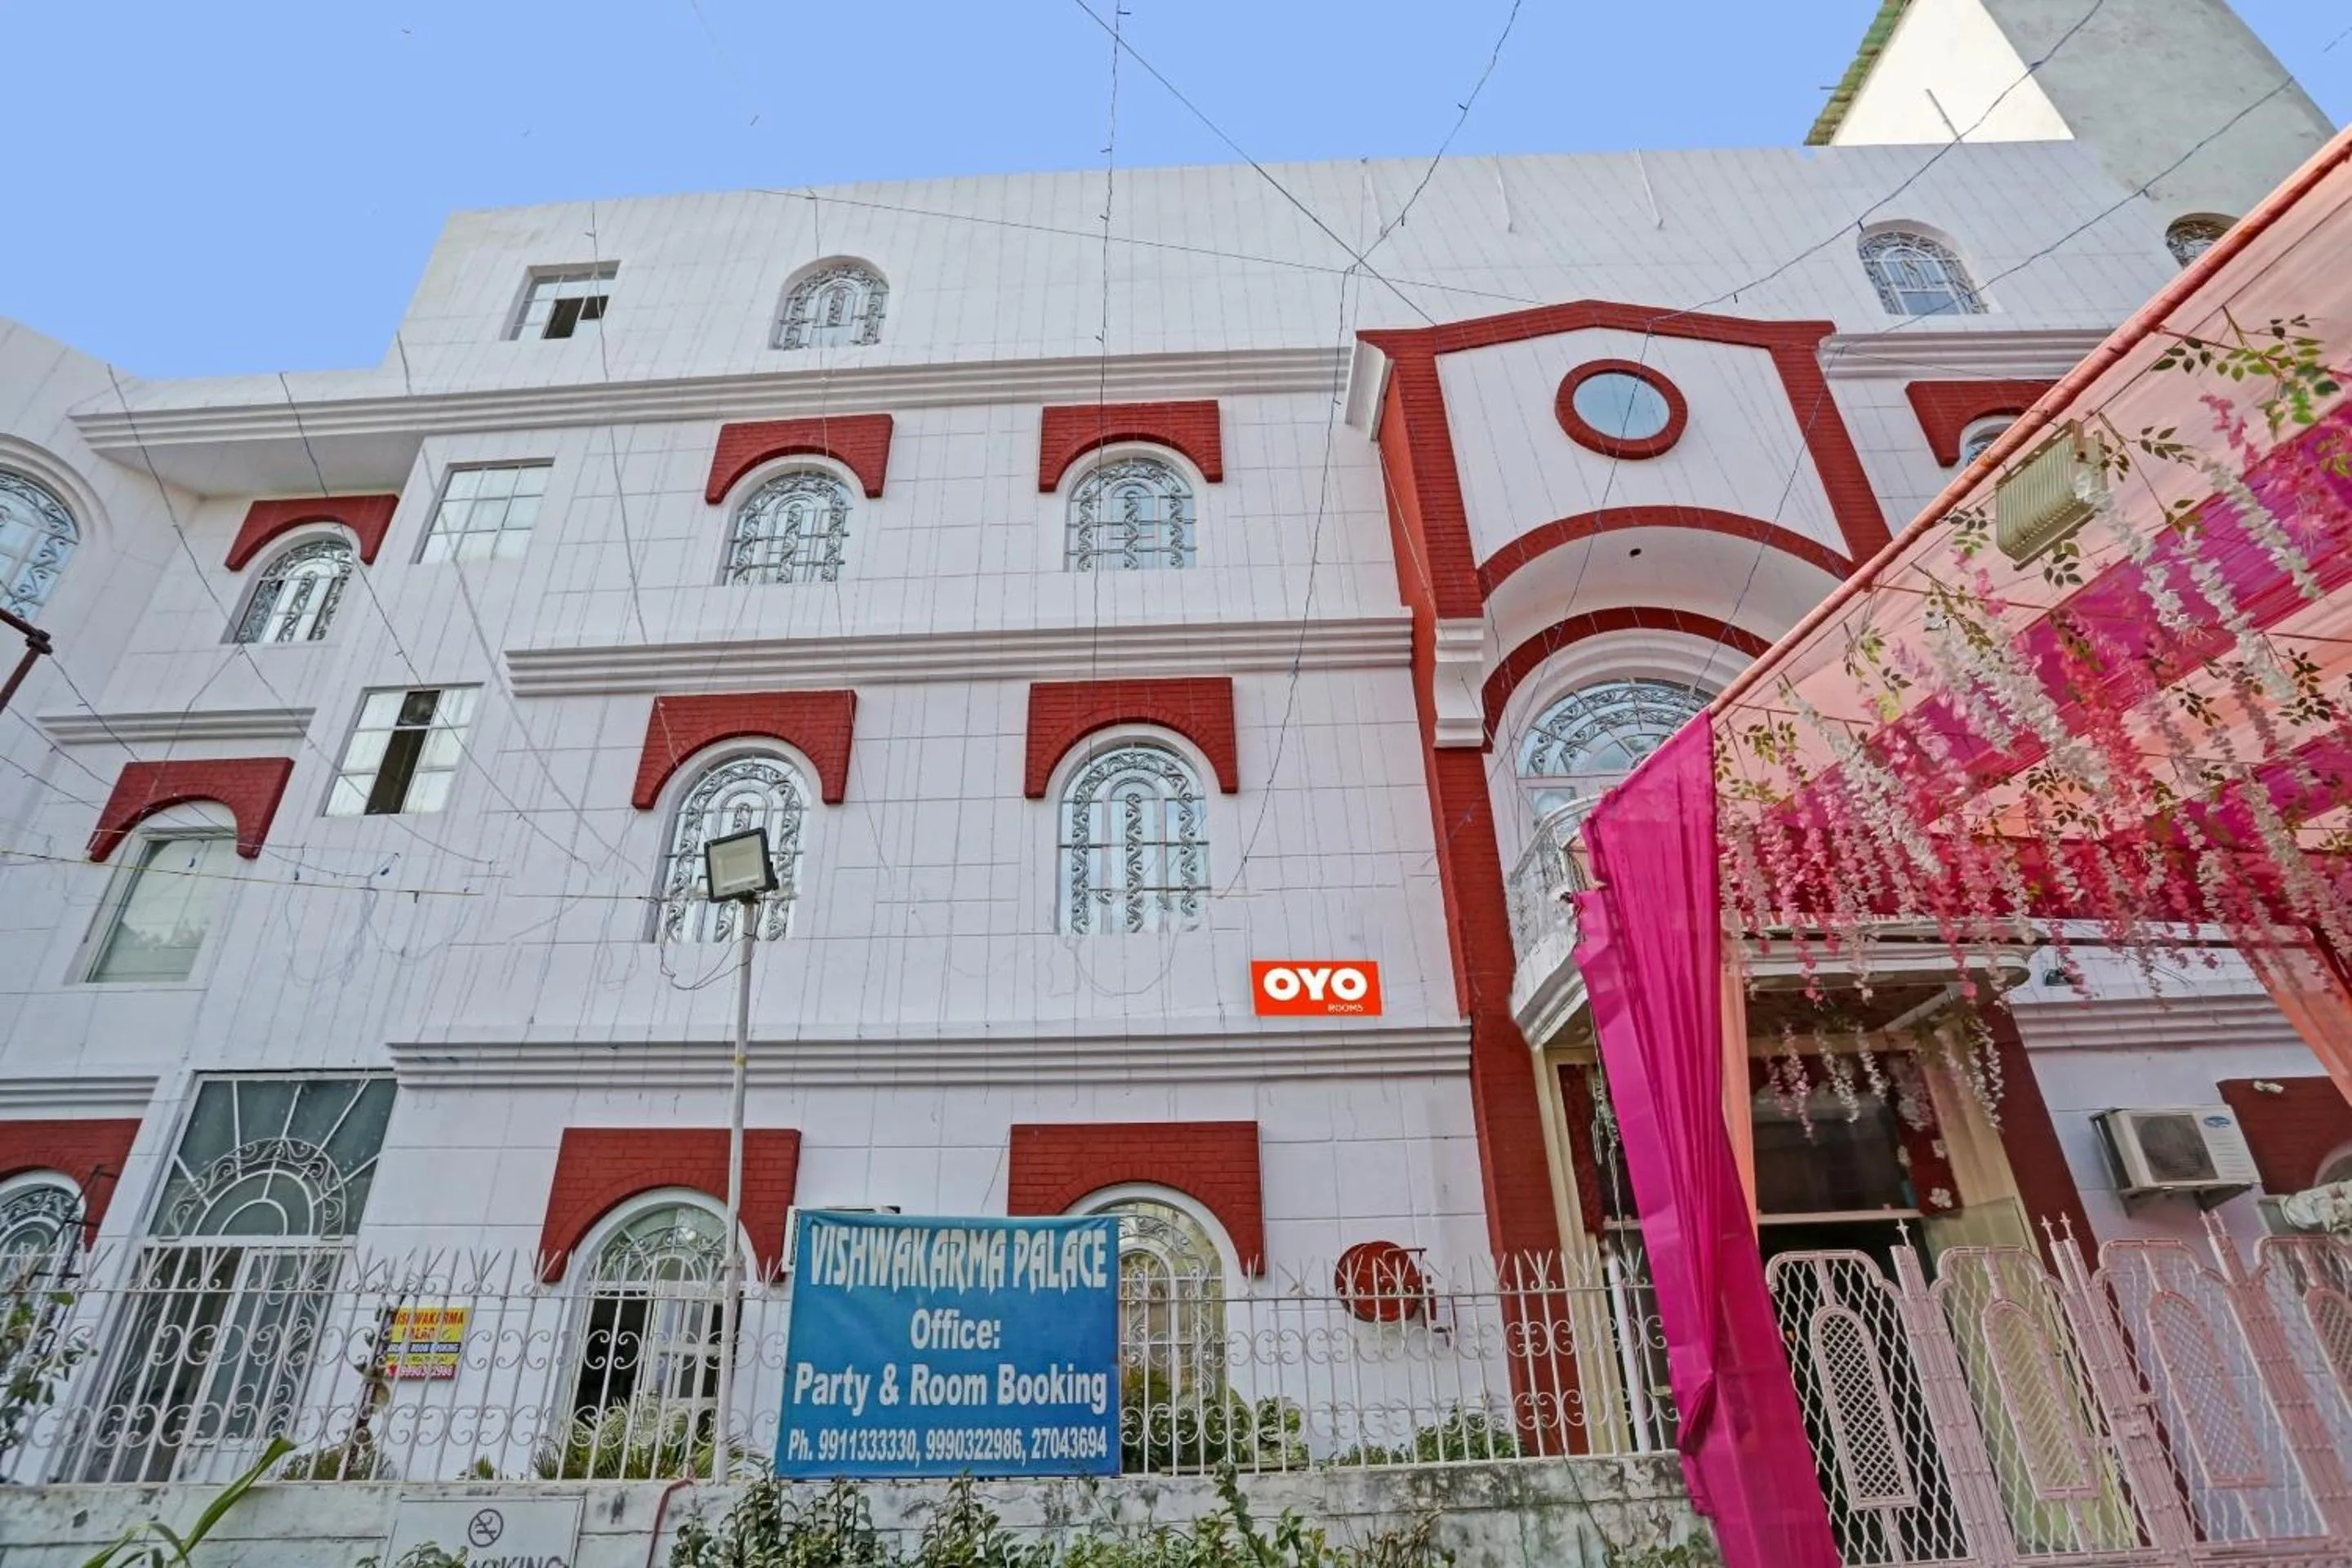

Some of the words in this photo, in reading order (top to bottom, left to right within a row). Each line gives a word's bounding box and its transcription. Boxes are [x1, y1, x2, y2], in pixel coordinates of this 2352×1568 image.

[1263, 968, 1368, 1001] OYO
[1328, 1004, 1364, 1013] ROOMS
[811, 1226, 1006, 1294] VISHWAKARMA
[1013, 1228, 1106, 1295] PALACE
[910, 1308, 1001, 1350] Office:
[792, 1362, 871, 1417] Party
[879, 1363, 899, 1405] &
[910, 1364, 987, 1406] Room
[997, 1364, 1107, 1414] Booking
[787, 1429, 813, 1461] Ph.
[817, 1428, 920, 1468] 9911333330,
[925, 1428, 1026, 1468] 9990322986,
[1031, 1426, 1107, 1460] 27043694
